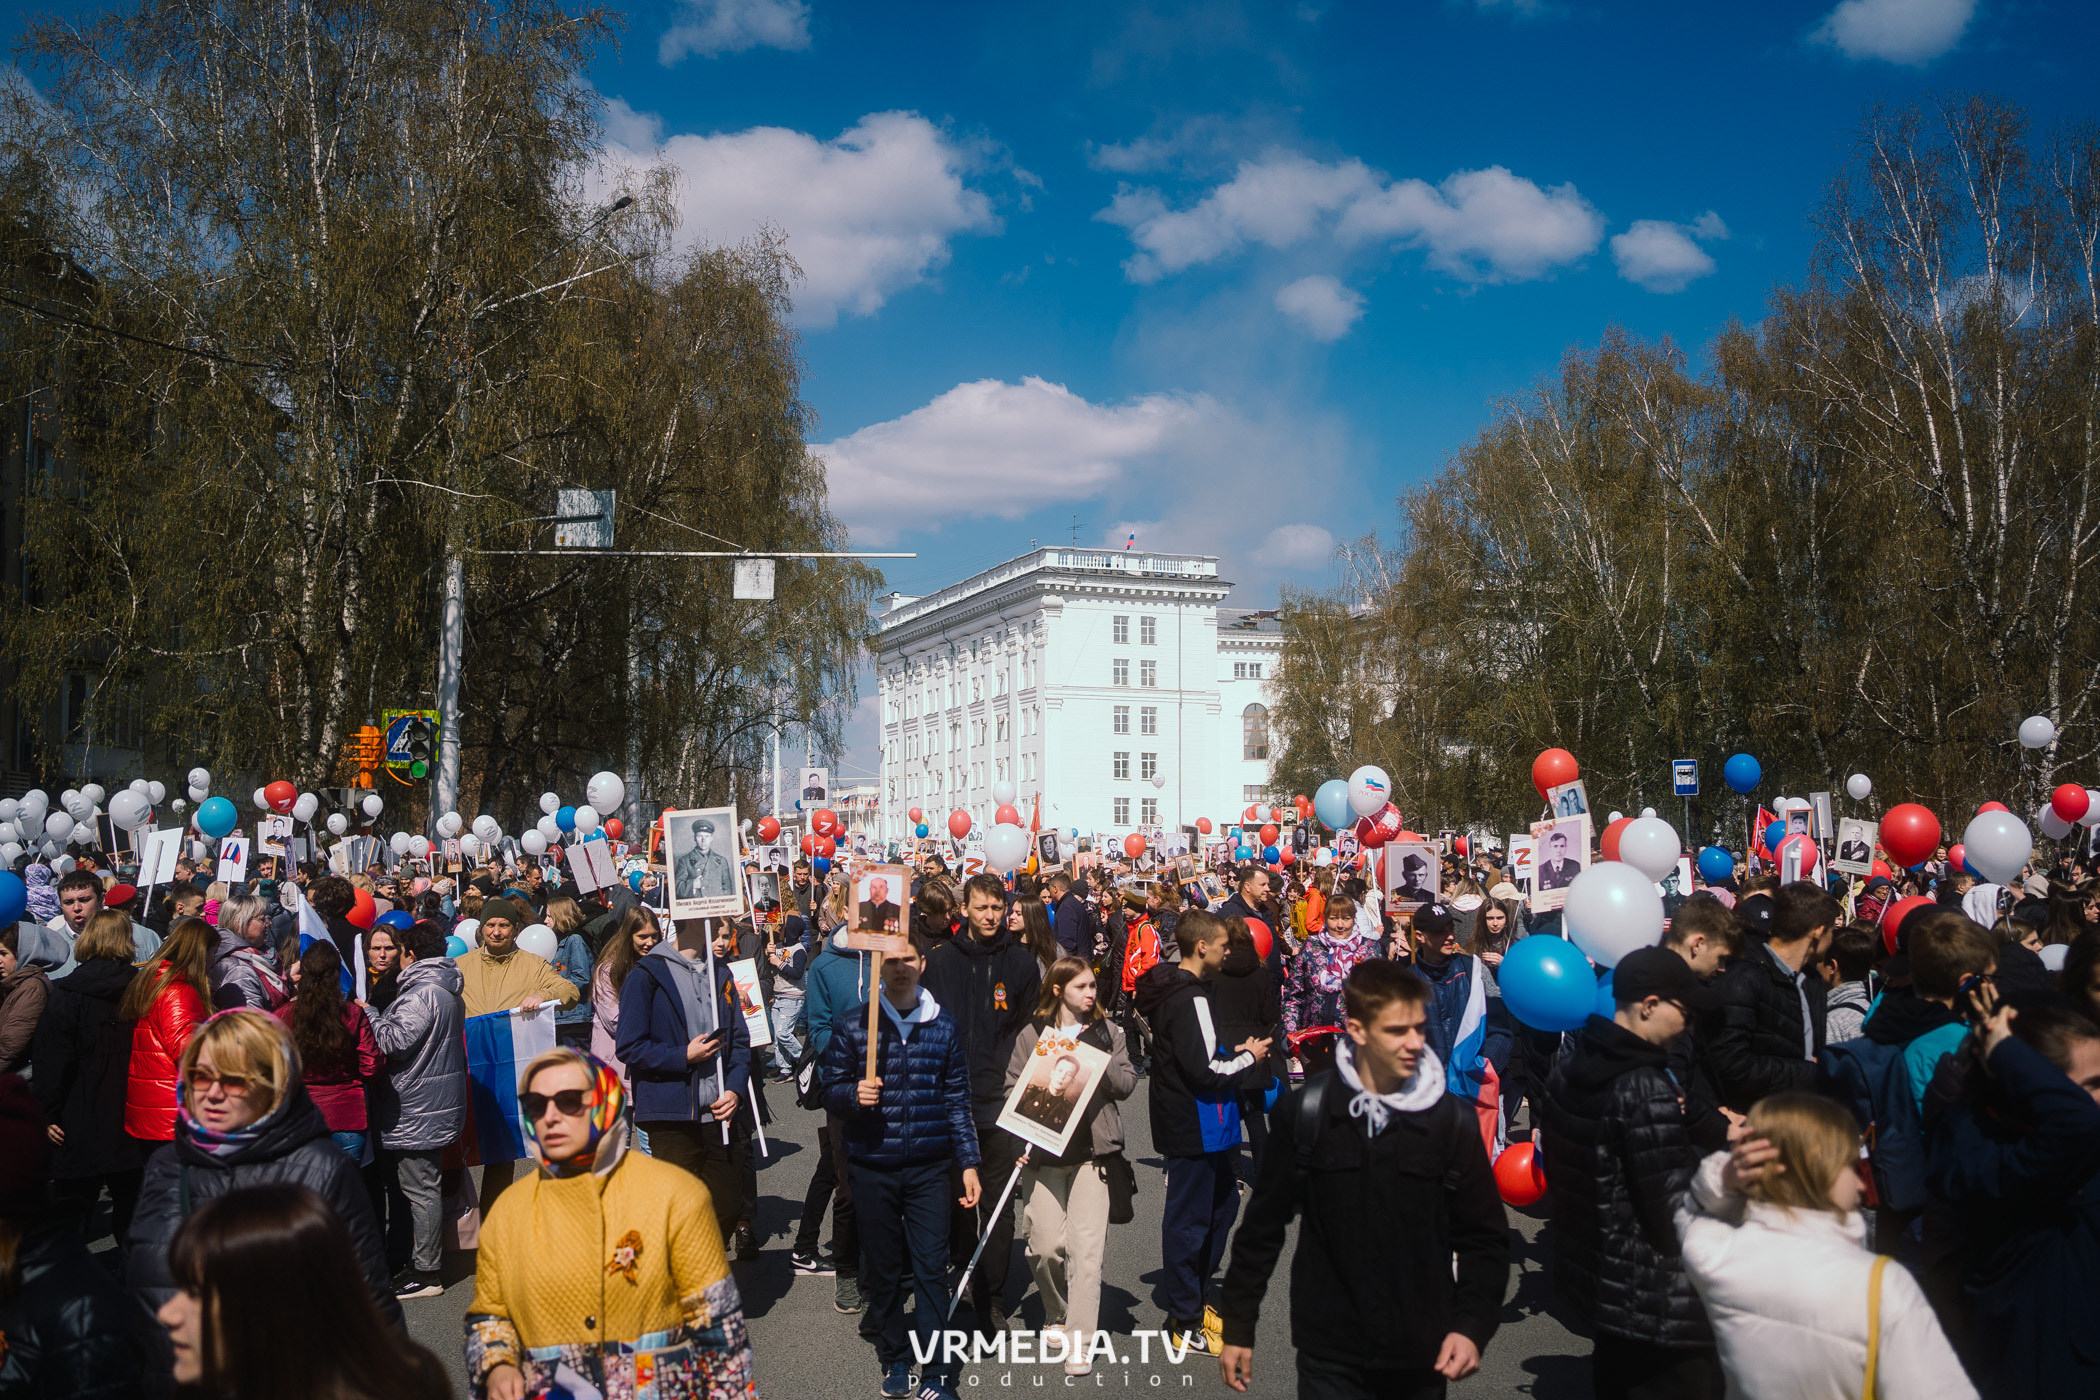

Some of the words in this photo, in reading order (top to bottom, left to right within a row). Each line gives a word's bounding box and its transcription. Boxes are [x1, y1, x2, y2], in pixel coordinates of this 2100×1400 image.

[70, 802, 83, 813] Z
[279, 799, 291, 811] Z
[134, 804, 150, 822] Z
[484, 826, 496, 836] Z
[819, 822, 832, 833] Z
[816, 846, 825, 855] Z
[903, 852, 913, 860] Z
[1514, 848, 1531, 866] Z
[965, 858, 983, 875] Z
